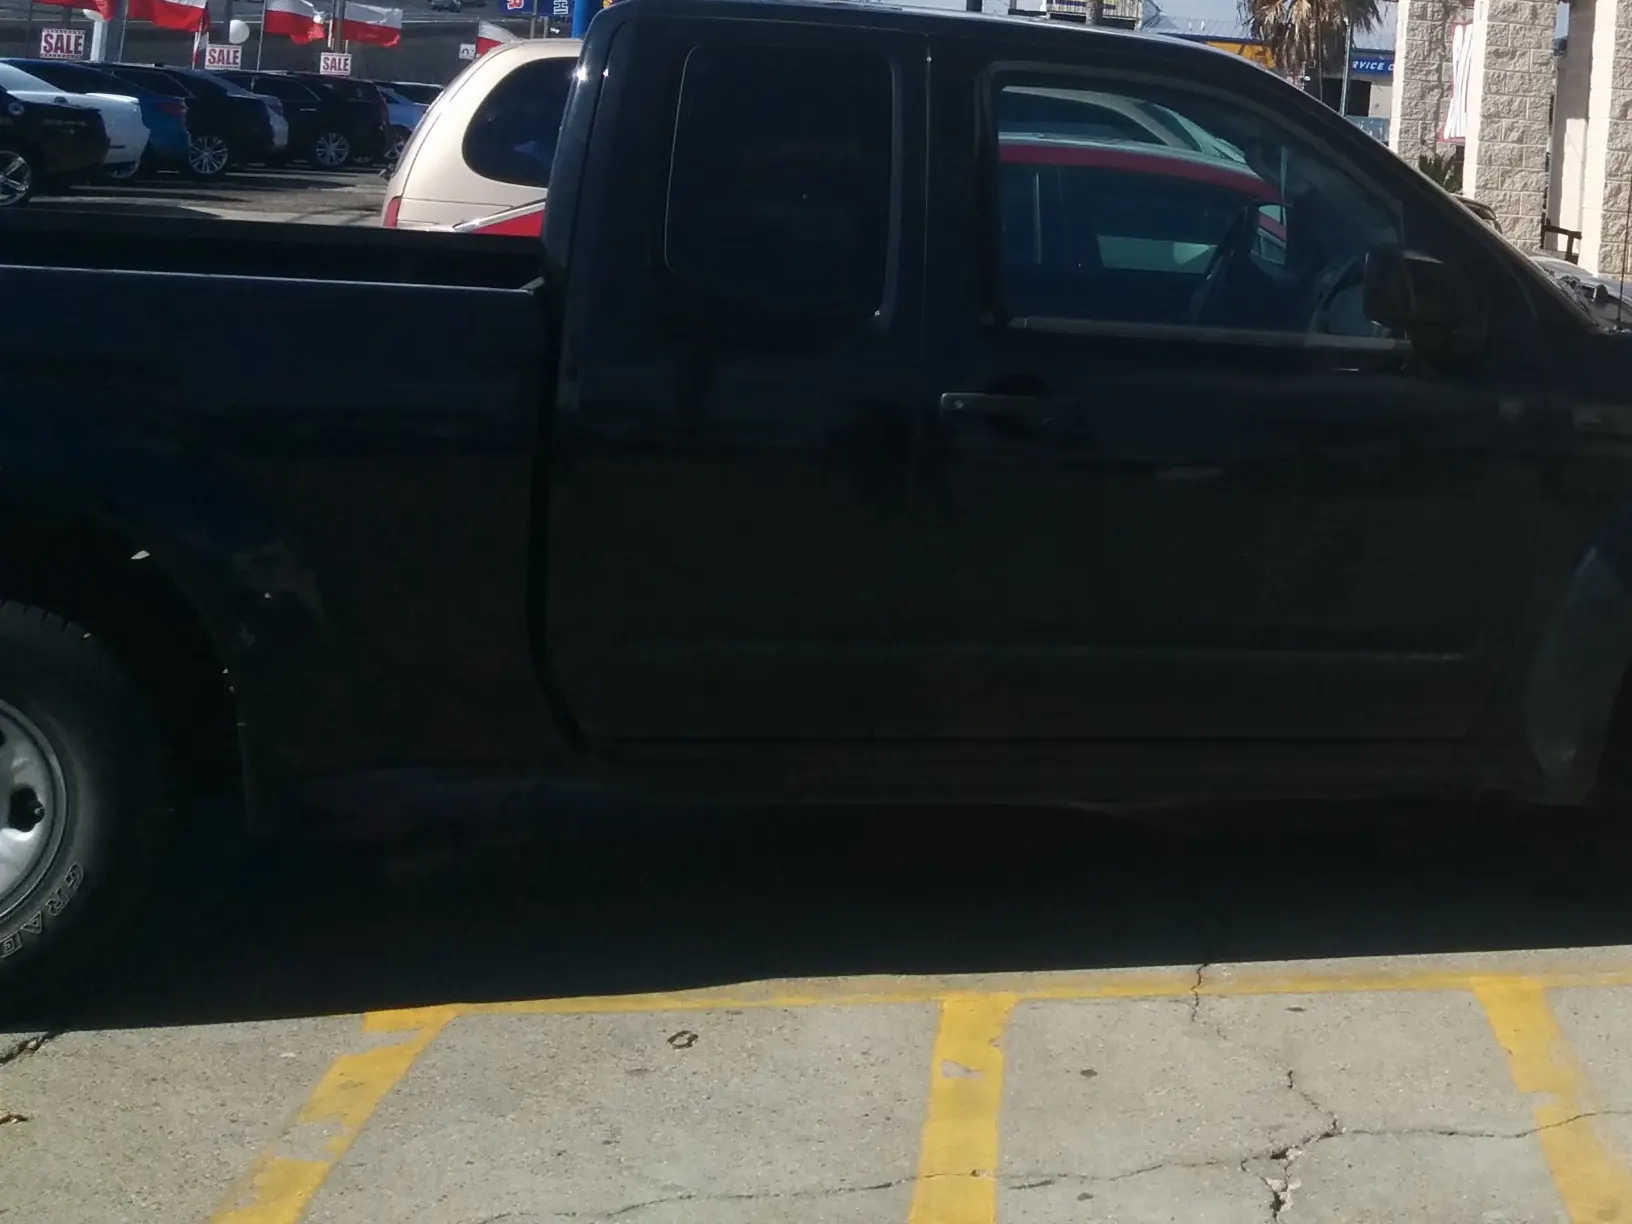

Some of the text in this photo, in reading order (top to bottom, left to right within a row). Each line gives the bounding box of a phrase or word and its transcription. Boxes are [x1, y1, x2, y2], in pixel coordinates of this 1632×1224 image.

[42, 32, 84, 57] SALE
[208, 48, 240, 67] SALE
[322, 56, 349, 73] SALE
